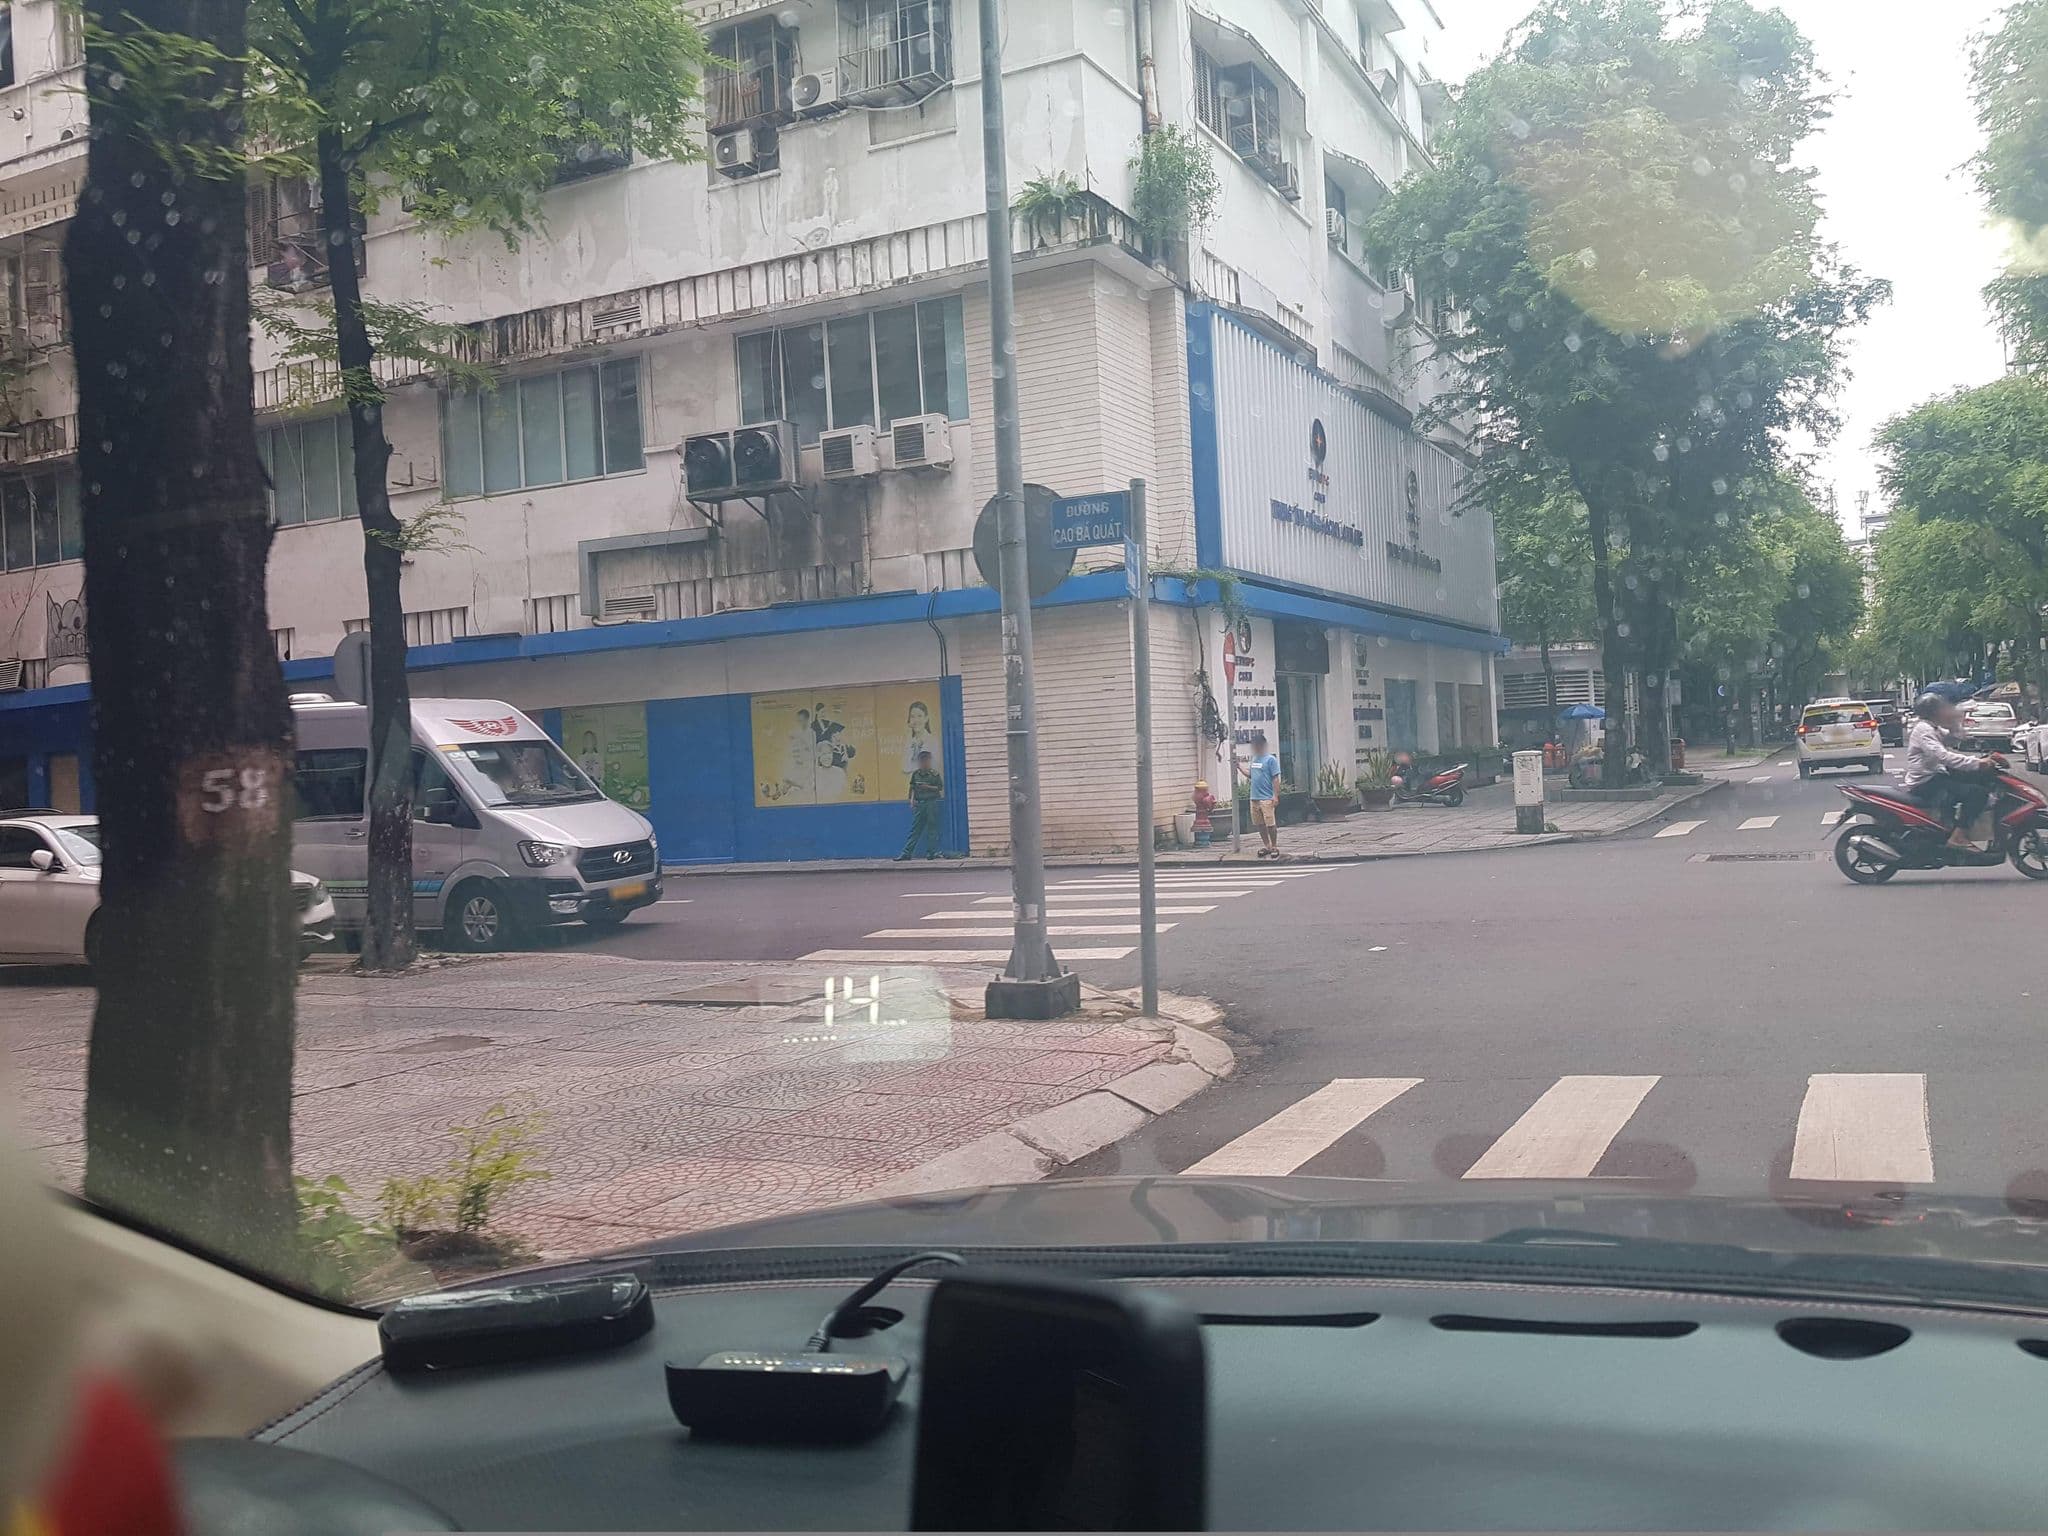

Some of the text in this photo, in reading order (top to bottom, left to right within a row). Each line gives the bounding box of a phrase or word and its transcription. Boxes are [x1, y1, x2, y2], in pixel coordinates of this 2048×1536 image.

[1066, 500, 1110, 518] ĐƯỜNG
[1054, 518, 1122, 544] CAO BÁ QUÁT
[202, 767, 269, 813] 58
[825, 975, 880, 1027] 14
